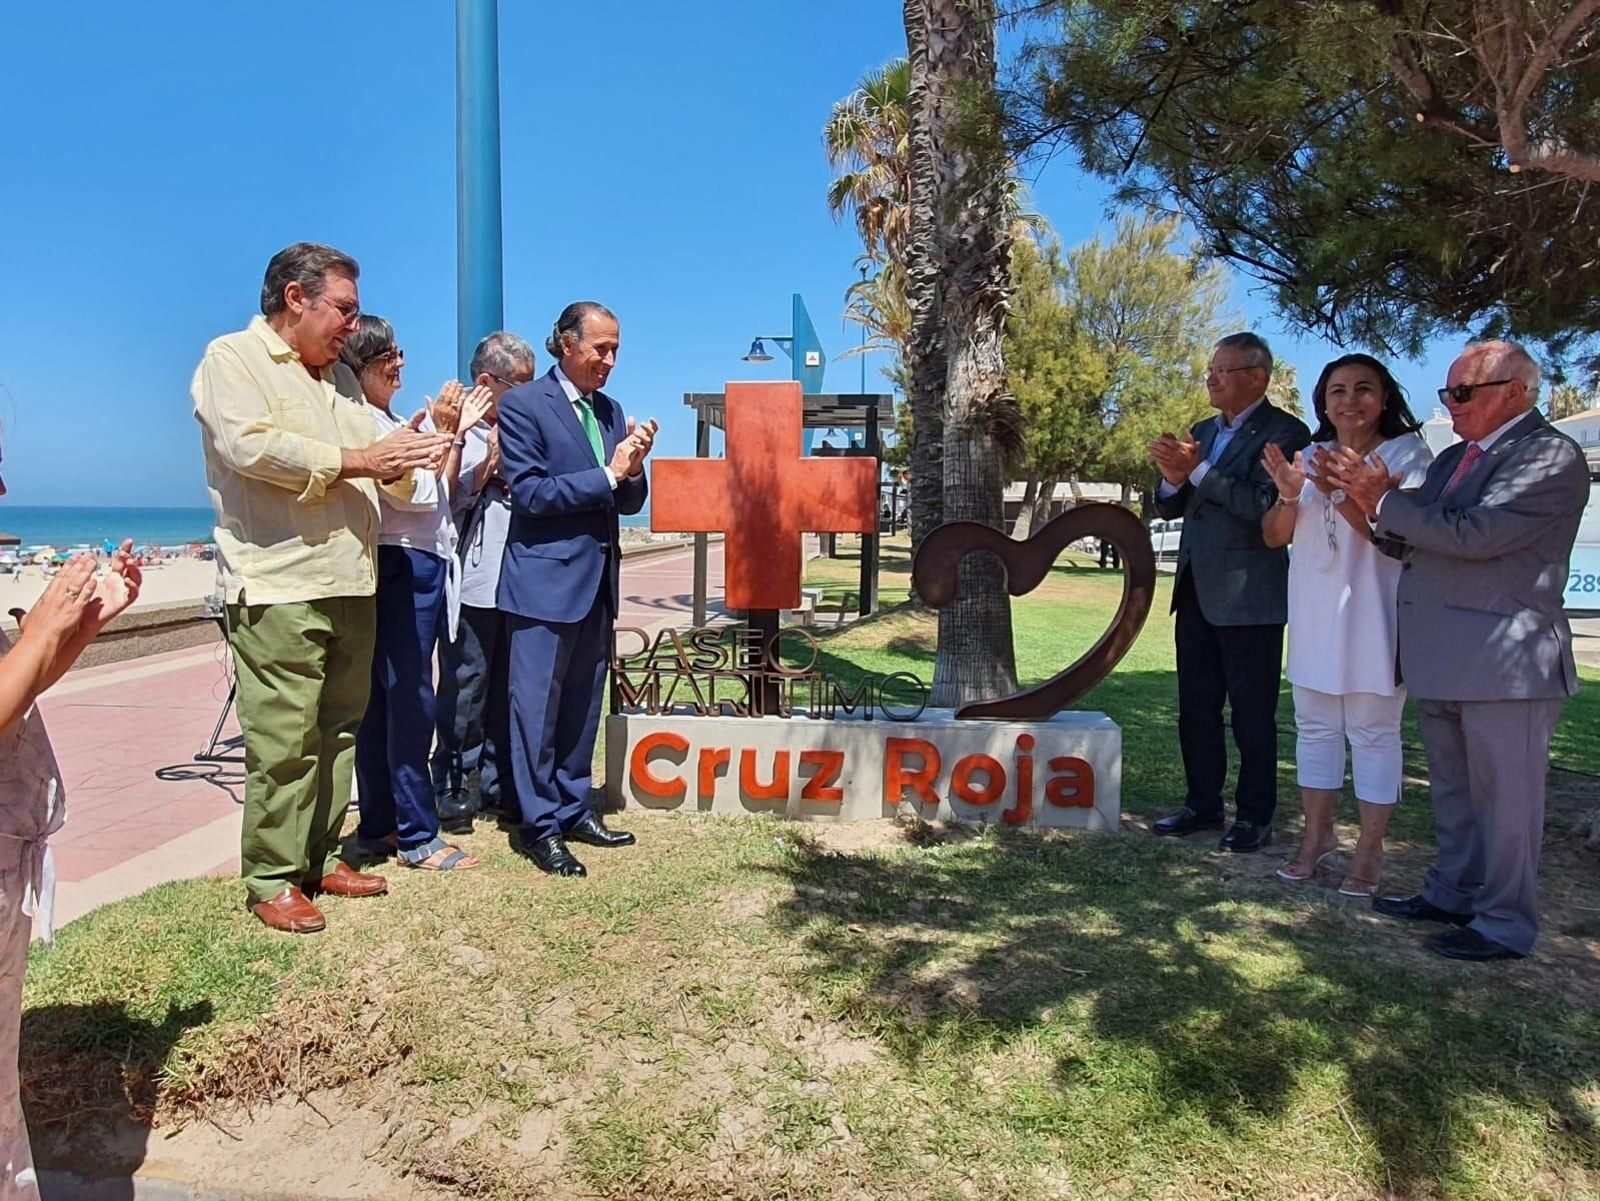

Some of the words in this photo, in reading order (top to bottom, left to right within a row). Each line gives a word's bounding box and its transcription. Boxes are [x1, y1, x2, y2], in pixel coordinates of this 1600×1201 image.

[611, 627, 818, 673] PASEO
[611, 671, 927, 721] MARITIMO
[630, 731, 845, 802] Cruz
[885, 733, 1096, 826] Roja
